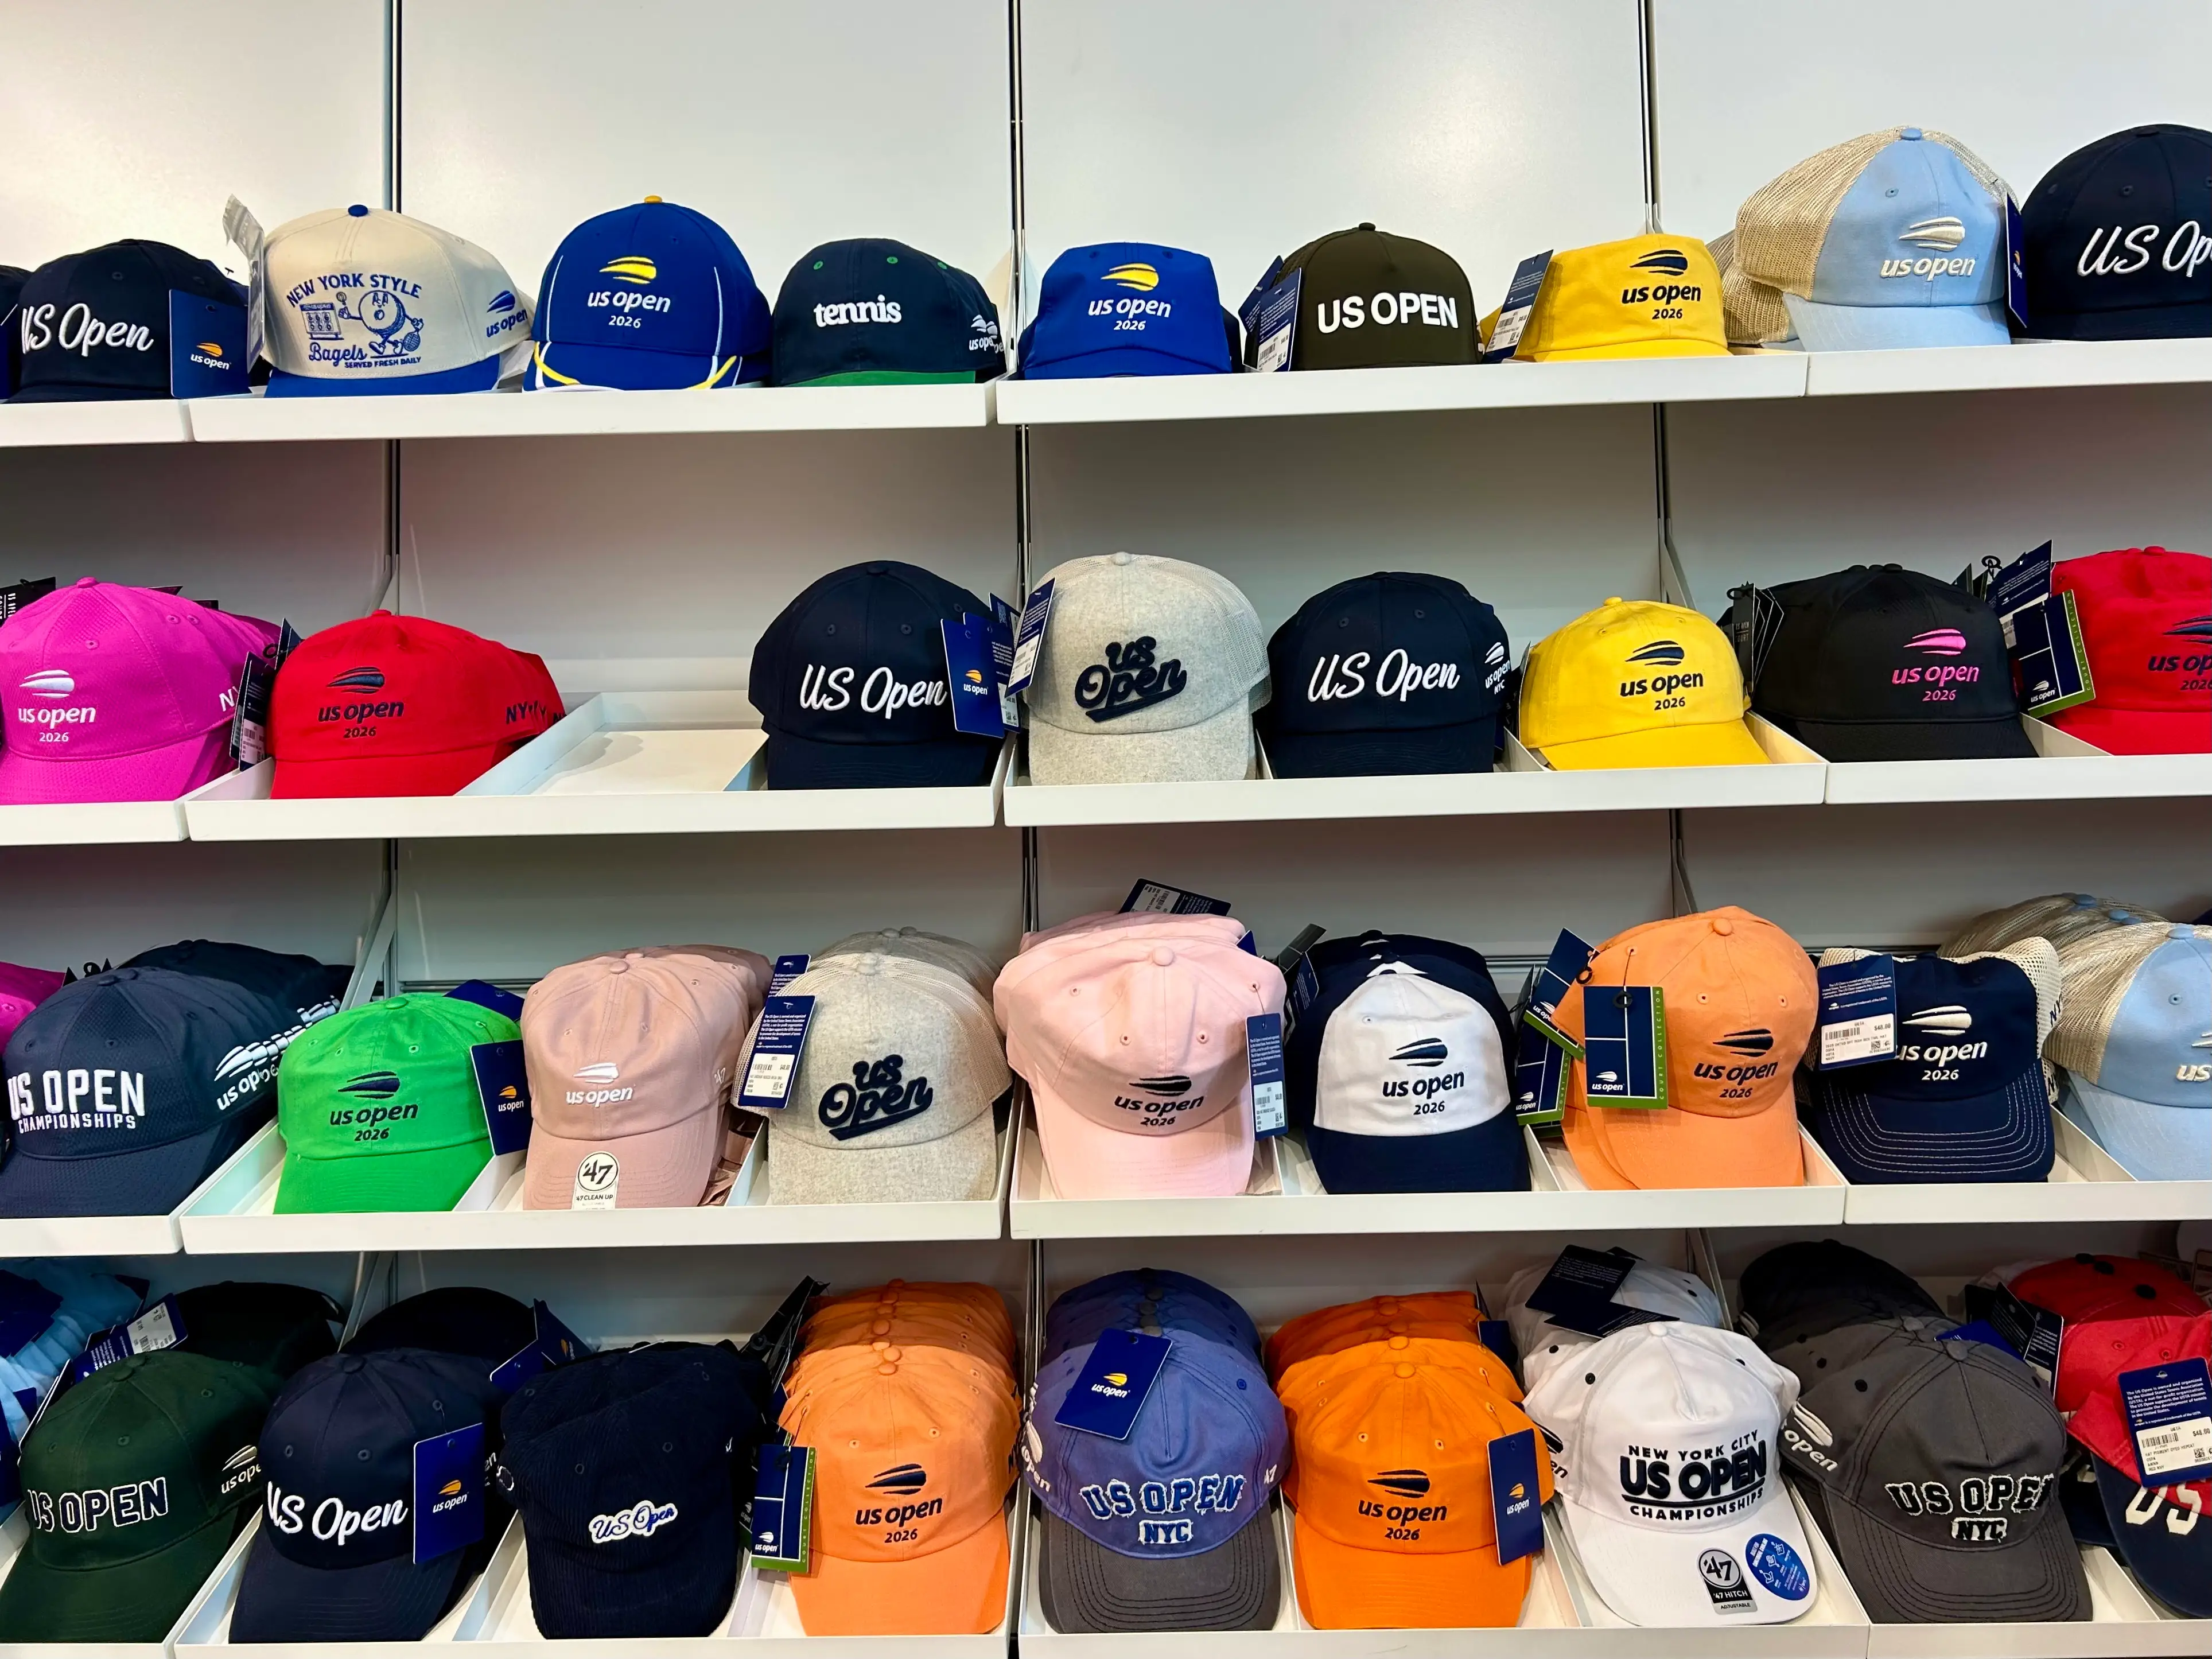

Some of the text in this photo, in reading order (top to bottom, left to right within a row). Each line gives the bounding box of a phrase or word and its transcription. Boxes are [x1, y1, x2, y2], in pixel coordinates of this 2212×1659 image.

[2077, 220, 2212, 278] US Op
[1880, 256, 1976, 282] us open
[286, 273, 422, 308] NEW YORK STYLE
[587, 289, 671, 313] us open
[1621, 284, 1701, 306] us open
[813, 294, 902, 328] tennis
[1088, 297, 1171, 319] us open
[1317, 296, 1366, 334] US
[1370, 292, 1459, 329] OPEN
[1651, 308, 1683, 320] 2026
[22, 303, 154, 358] US Open
[486, 309, 527, 338] us open
[608, 314, 642, 329] 2026
[1113, 320, 1146, 331] 2026
[309, 341, 368, 367] Bagels
[969, 339, 979, 351] us
[191, 353, 230, 370] us open
[374, 359, 399, 367] FRESH
[401, 356, 422, 365] DAILY
[1485, 659, 1511, 689] us open
[2148, 654, 2181, 672] us
[1074, 658, 1188, 710] Open
[1307, 648, 1460, 703] US Open
[1494, 679, 1506, 695] NYC
[1620, 671, 1704, 697] us open
[1891, 665, 1980, 686] us open
[800, 663, 948, 720] US Open
[963, 683, 988, 696] us open
[1922, 690, 1957, 702] 2026
[2030, 689, 2056, 703] us open
[317, 701, 405, 724] us open
[1654, 696, 1686, 711] 2026
[18, 706, 96, 729] us open
[38, 732, 69, 743] 2026
[343, 726, 376, 739] 2026
[1533, 1005, 1541, 1014] us
[1655, 990, 1663, 1058] COLLECTION
[1923, 1041, 1988, 1067] open
[1382, 1071, 1465, 1098] us open
[1694, 1061, 1778, 1085] us open
[1922, 1069, 1960, 1081] 2026
[7, 1068, 145, 1120] US OPEN
[216, 1085, 239, 1110] us
[566, 1086, 633, 1108] us open
[1592, 1082, 1624, 1092] us open
[1719, 1087, 1752, 1098] 2026
[498, 1100, 524, 1112] us open
[818, 1075, 934, 1128] Open
[1114, 1095, 1204, 1117] us open
[1413, 1100, 1445, 1116] 2026
[1522, 1102, 1537, 1110] open
[18, 1112, 137, 1135] CHAMPIONSHIPS
[329, 1104, 419, 1127] us open
[1140, 1116, 1176, 1127] 2026
[354, 1127, 390, 1141] 2026
[1091, 1382, 1128, 1398] us open
[1628, 1429, 1758, 1462] NEW YORK CITY
[1785, 1429, 1838, 1472] open
[1620, 1440, 1767, 1499] US OPEN
[220, 1475, 238, 1494] us
[28, 1477, 169, 1534] US OPEN
[433, 1493, 467, 1514] us open
[1079, 1474, 1247, 1520] US OPEN
[1506, 1498, 1530, 1515] us open
[1630, 1487, 1763, 1521] CHAMPIONSHIPS
[1886, 1480, 1954, 1516] US
[267, 1481, 408, 1546] US Open
[593, 1505, 675, 1540] US Open
[855, 1497, 943, 1528] us open
[1358, 1499, 1448, 1527] us open
[884, 1528, 918, 1544] 2026
[1140, 1520, 1194, 1544] NYC
[1384, 1527, 1420, 1541] 2026
[1951, 1518, 2008, 1542] NYC
[762, 1544, 777, 1554] open
[1724, 1590, 1748, 1598] HITCH
